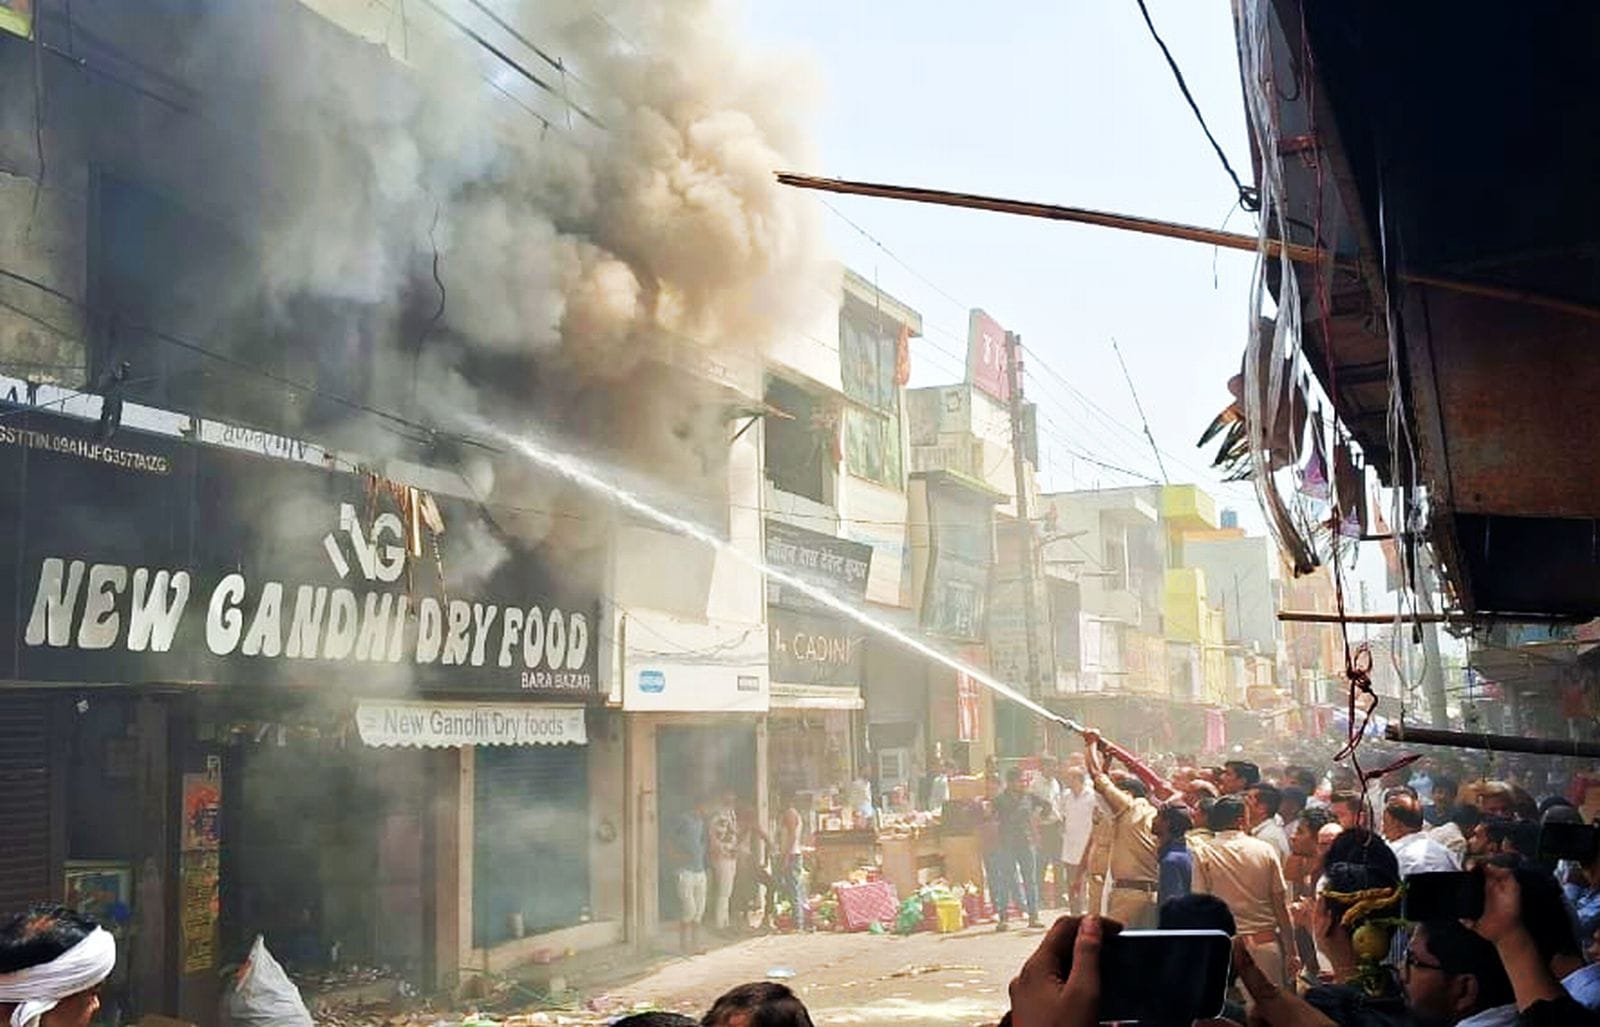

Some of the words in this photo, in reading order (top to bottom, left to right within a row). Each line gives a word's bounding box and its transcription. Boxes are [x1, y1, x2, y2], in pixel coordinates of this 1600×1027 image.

[25, 557, 191, 652] NEW
[206, 573, 408, 663] GANDHI
[416, 598, 498, 666] DRY
[498, 605, 589, 670] FOOD
[521, 672, 552, 690] BARA
[554, 673, 591, 690] BAZAR
[383, 708, 424, 735] New
[429, 709, 490, 738] Gandhi
[494, 711, 520, 740] Dry
[524, 711, 564, 736] foods
